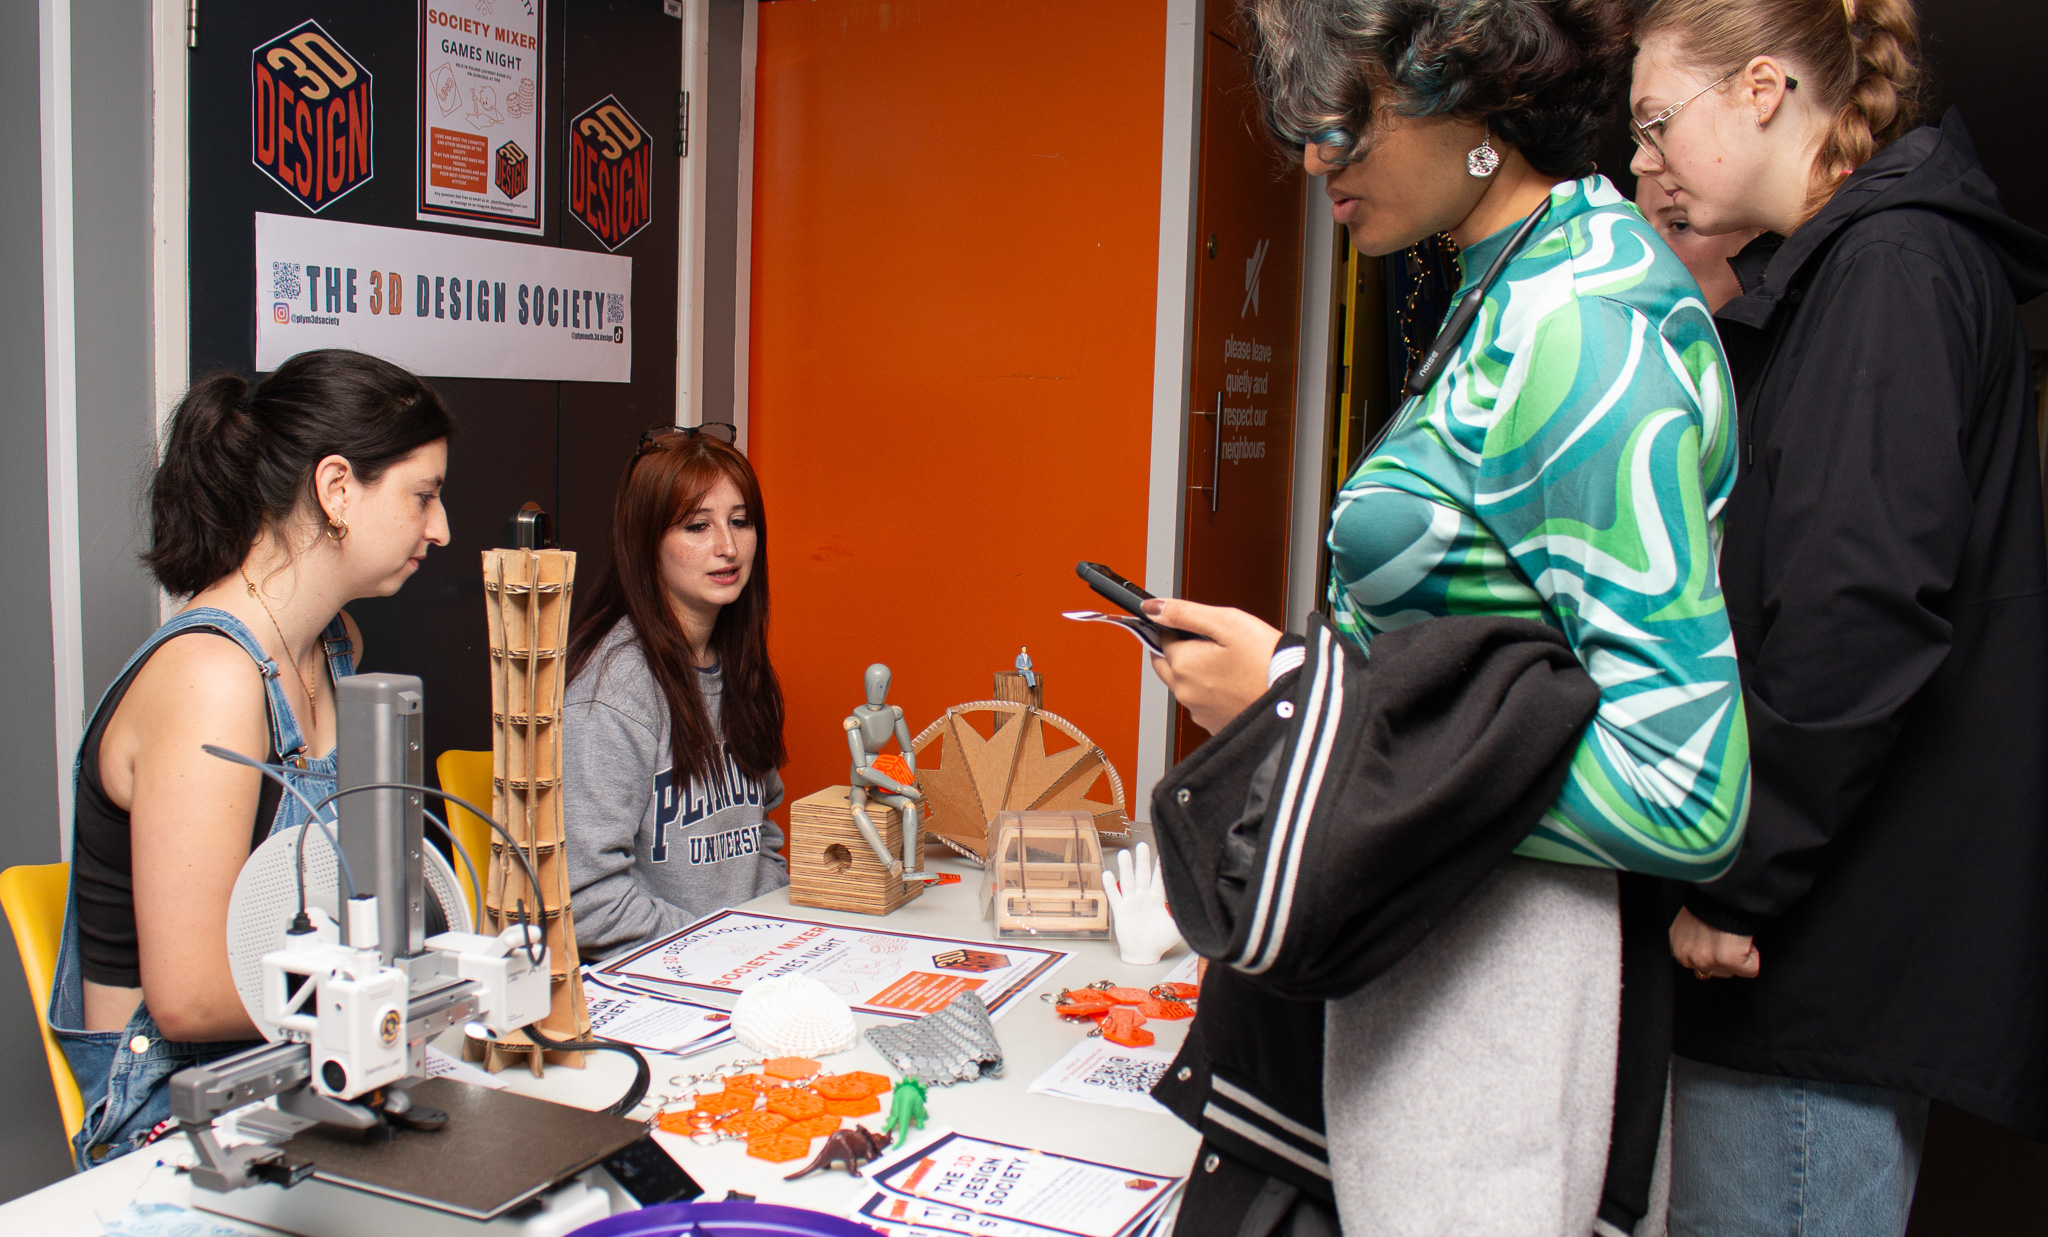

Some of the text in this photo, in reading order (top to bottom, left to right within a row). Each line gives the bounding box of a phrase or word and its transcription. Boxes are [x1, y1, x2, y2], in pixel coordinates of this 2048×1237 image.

[429, 9, 536, 51] SOCIETY MIXER
[267, 32, 357, 100] 3D
[441, 38, 522, 71] GAMES NIGHT
[256, 62, 368, 202] DESIGN
[579, 104, 641, 160] 3D
[499, 142, 525, 165] 3D
[496, 153, 527, 197] DESIGN
[572, 129, 648, 242] DESIGN
[306, 265, 605, 330] THE 3D DESIGN SOCIETY
[291, 314, 340, 326] @plym3dsociety
[1225, 334, 1272, 363] please leave
[1419, 350, 1439, 377] noise
[1225, 368, 1268, 400] quietly and
[1223, 405, 1267, 432] respect our
[1221, 434, 1266, 466] neighbours
[688, 823, 762, 866] UNIVERSI
[662, 923, 786, 978] THE 3D DESIGN SOCIETY
[711, 950, 783, 986] SOCIETY
[777, 926, 830, 951] MIXER
[758, 958, 809, 981] AMES
[800, 937, 847, 960] NIGHT
[934, 950, 966, 967] 3D
[934, 1171, 964, 1192] THE
[953, 1155, 976, 1169] 3D
[960, 1157, 1003, 1199] DESIGN
[984, 1157, 1030, 1207] SOCIETY
